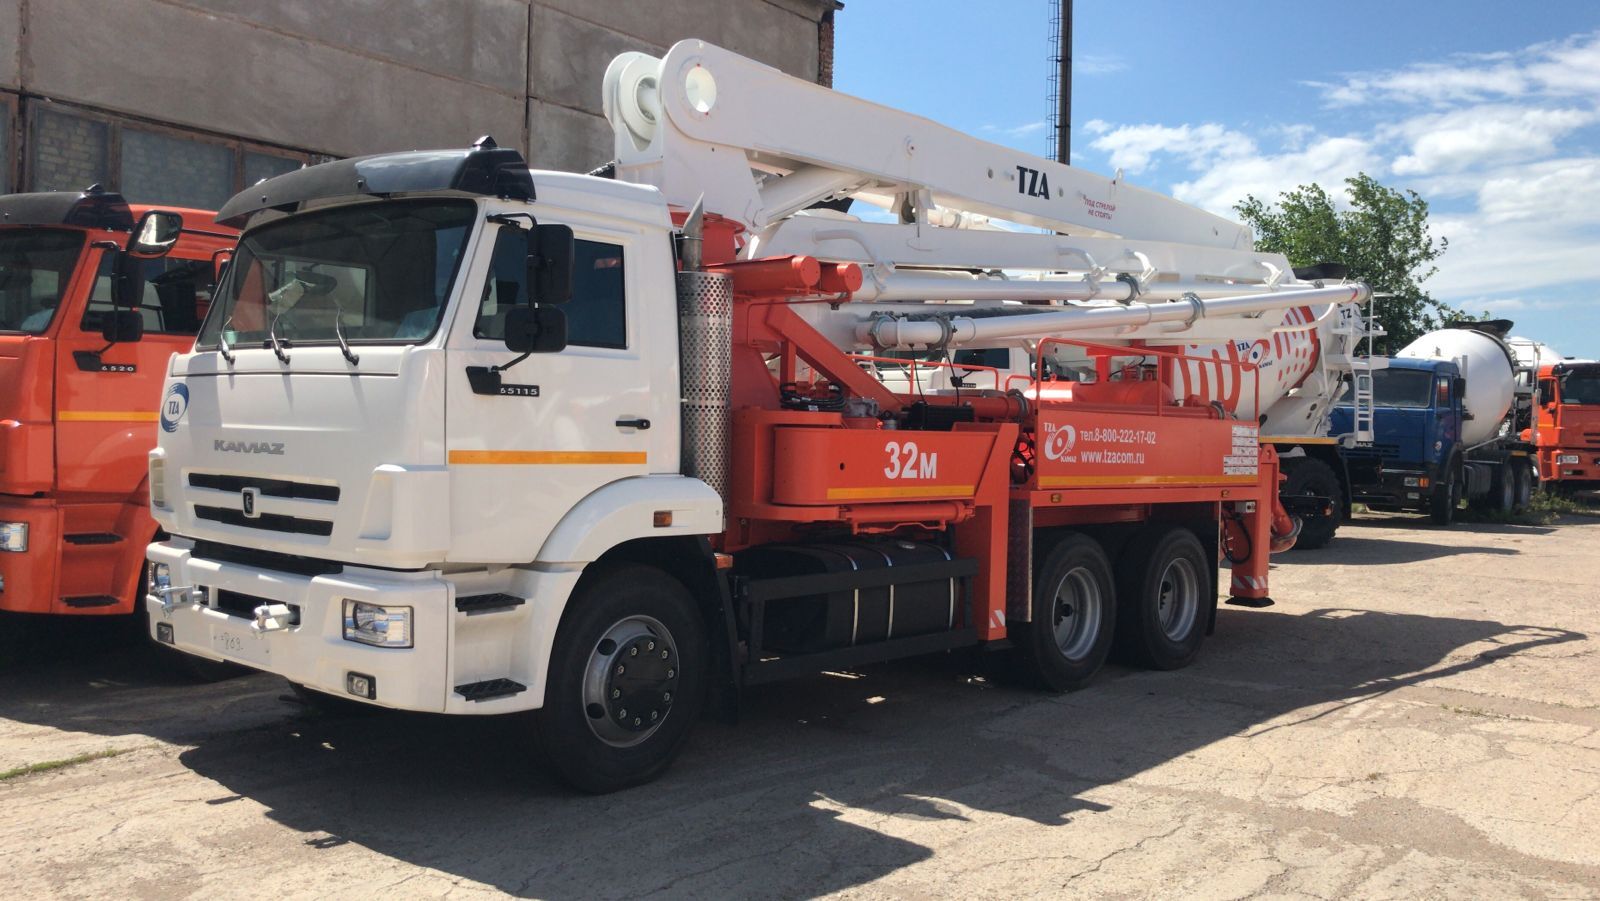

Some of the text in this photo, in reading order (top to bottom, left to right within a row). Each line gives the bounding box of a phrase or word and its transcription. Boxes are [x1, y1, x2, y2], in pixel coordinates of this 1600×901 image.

[1016, 165, 1050, 200] TZA
[1237, 341, 1250, 352] TZA
[500, 387, 538, 396] 65115
[168, 401, 179, 415] TZA
[1044, 422, 1056, 432] TZA
[214, 439, 285, 455] KAMAZ
[1080, 449, 1145, 464] www.tzacom.ru
